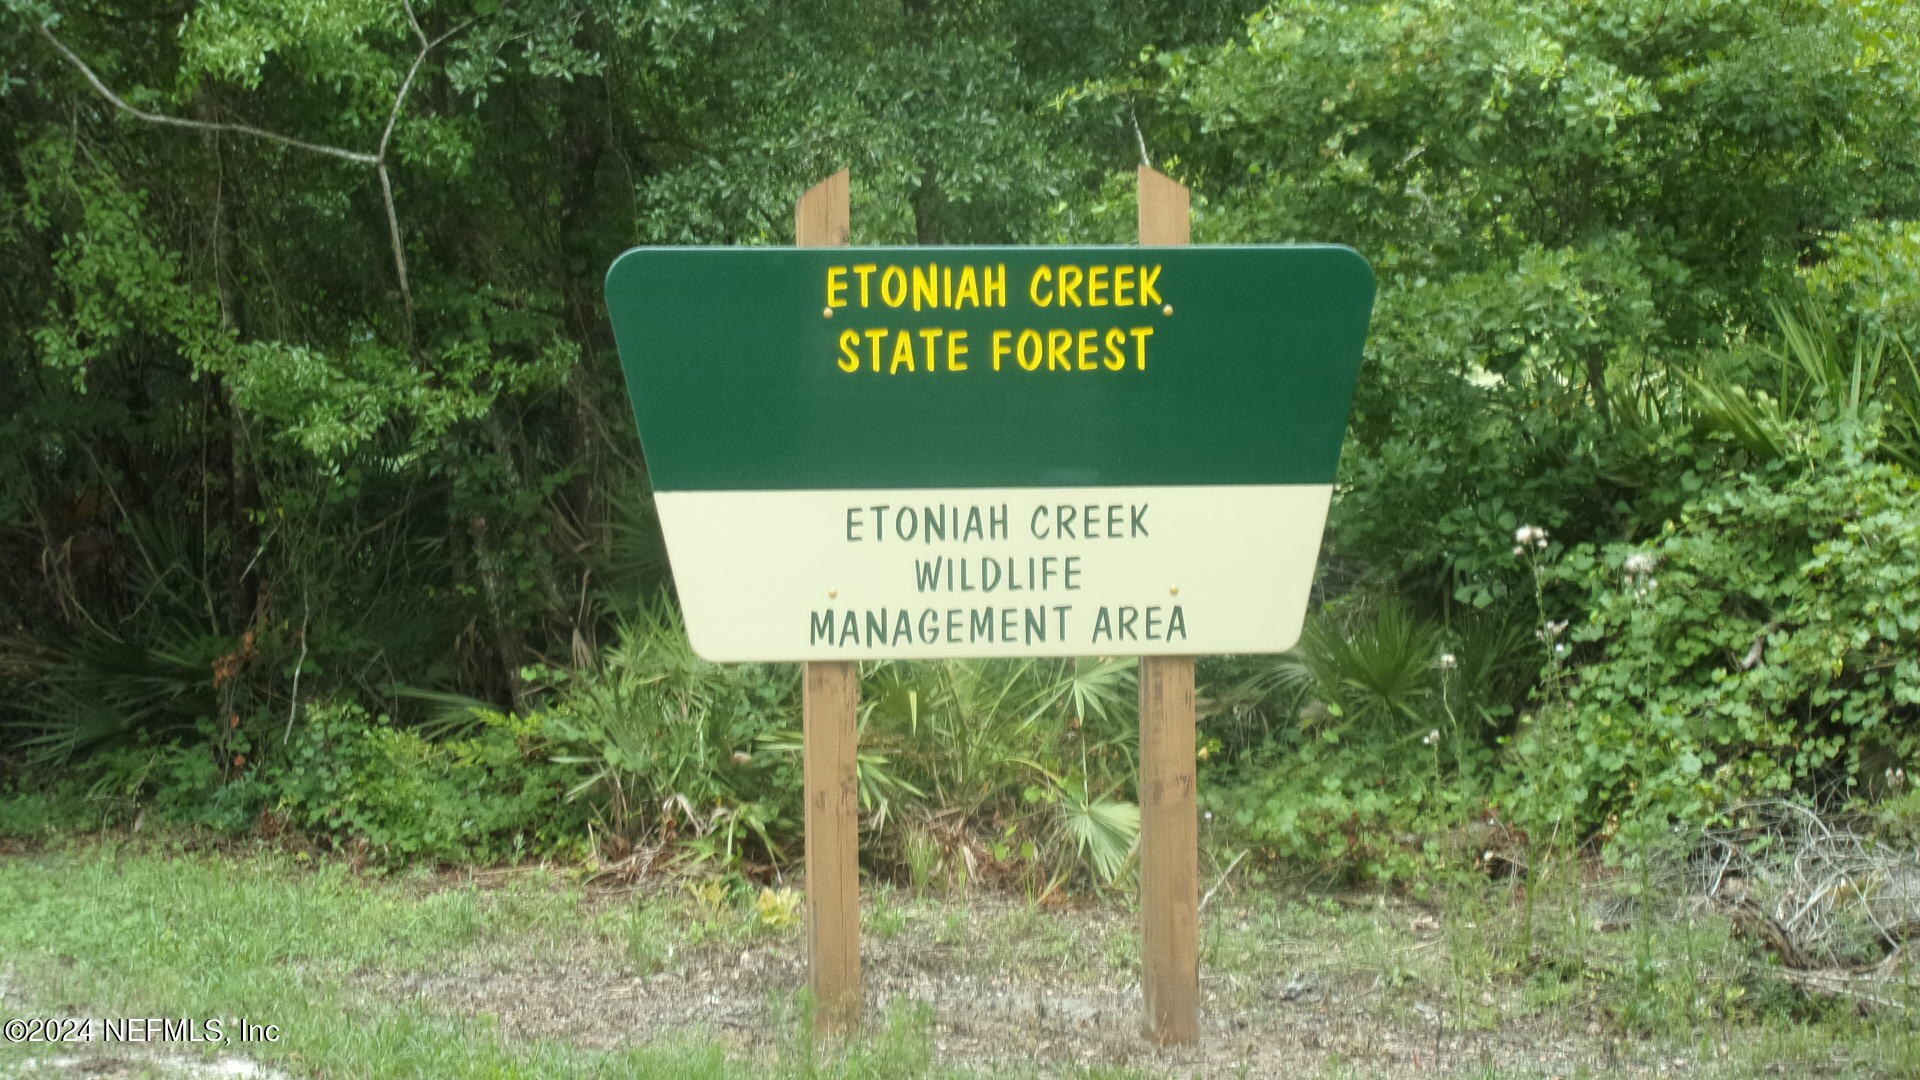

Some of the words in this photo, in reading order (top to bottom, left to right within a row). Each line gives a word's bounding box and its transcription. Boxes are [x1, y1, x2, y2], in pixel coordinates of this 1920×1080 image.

[826, 263, 1008, 311] ETONIAH
[1030, 263, 1164, 307] CREEK
[837, 327, 969, 374] STATE
[992, 326, 1155, 372] FOREST
[846, 503, 1009, 543] ETONIAH
[1030, 503, 1150, 540] CREEK
[914, 556, 1083, 593] WILDLIFE
[809, 605, 1072, 649] MANAGEMENT
[1091, 604, 1188, 642] AREA
